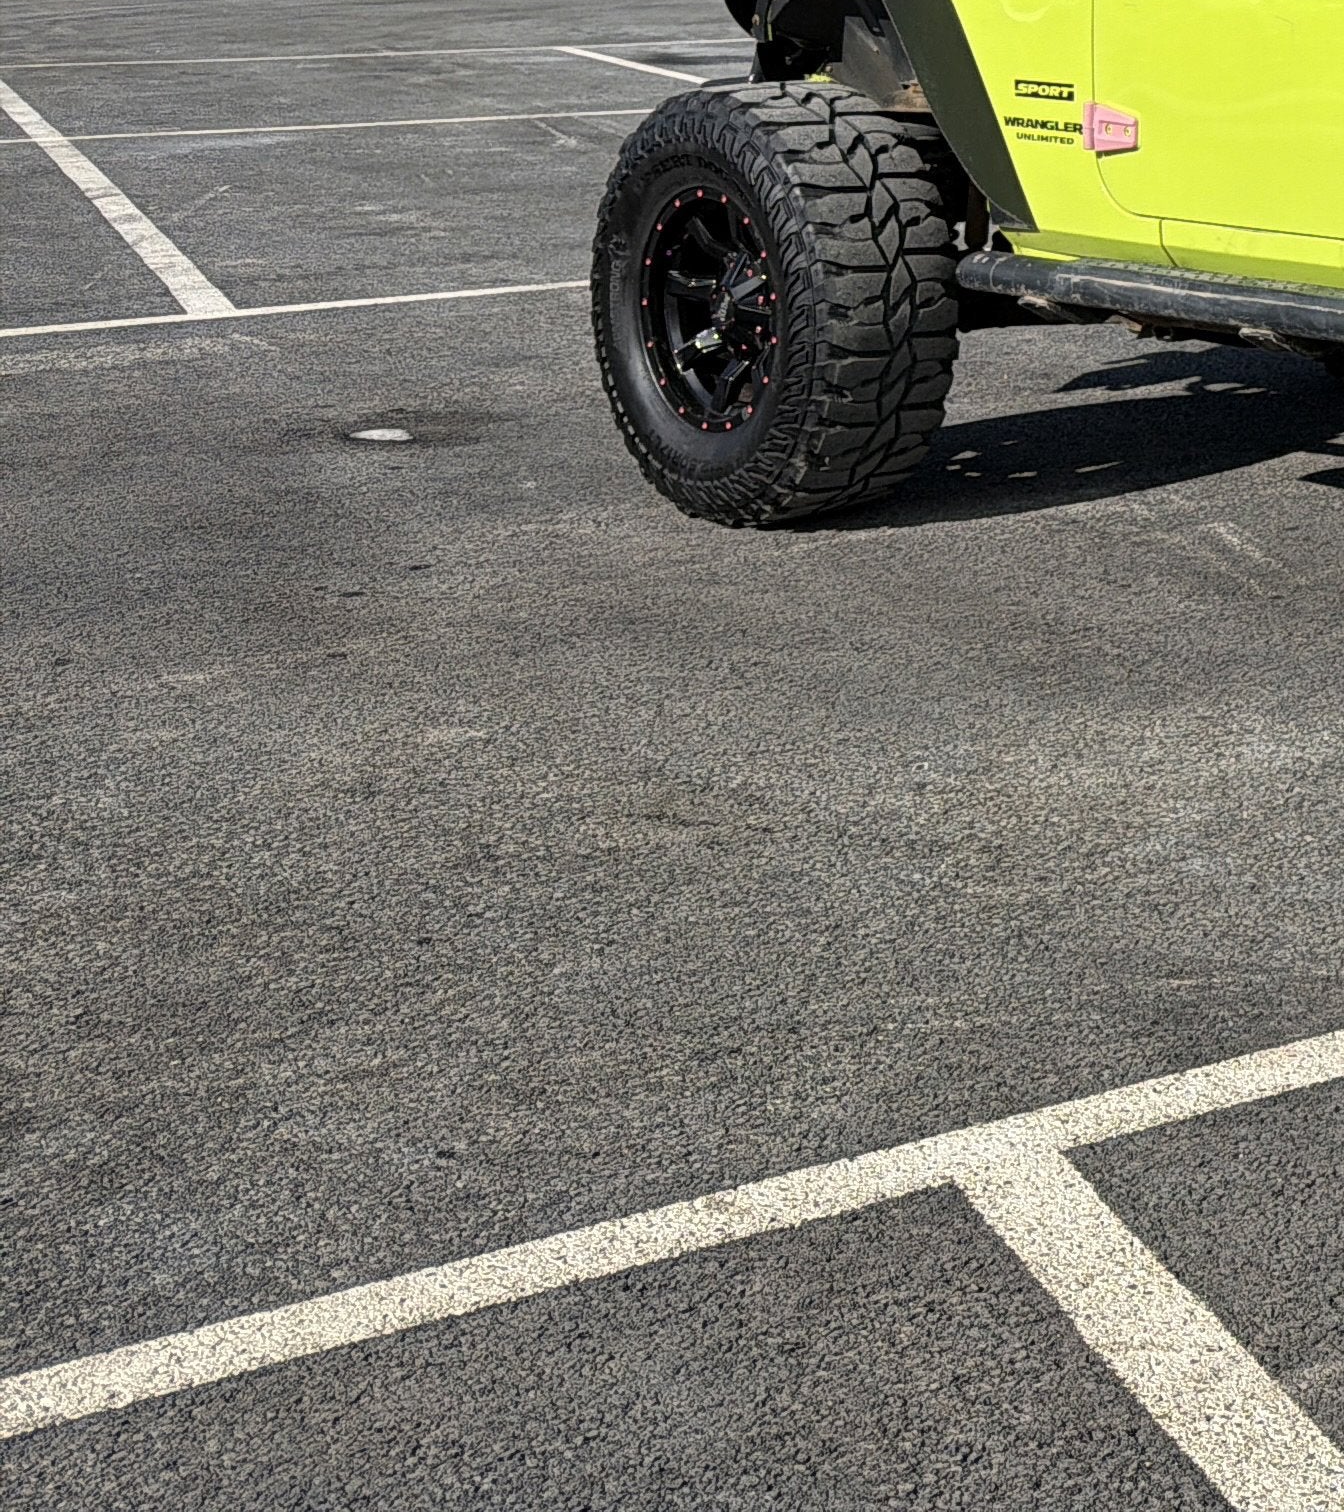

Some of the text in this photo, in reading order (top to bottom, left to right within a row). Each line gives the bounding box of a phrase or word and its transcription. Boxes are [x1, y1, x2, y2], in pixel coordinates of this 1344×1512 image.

[1016, 82, 1071, 98] SPORT
[1004, 115, 1083, 135] WRANGLER
[1016, 132, 1075, 145] UNLIMITED
